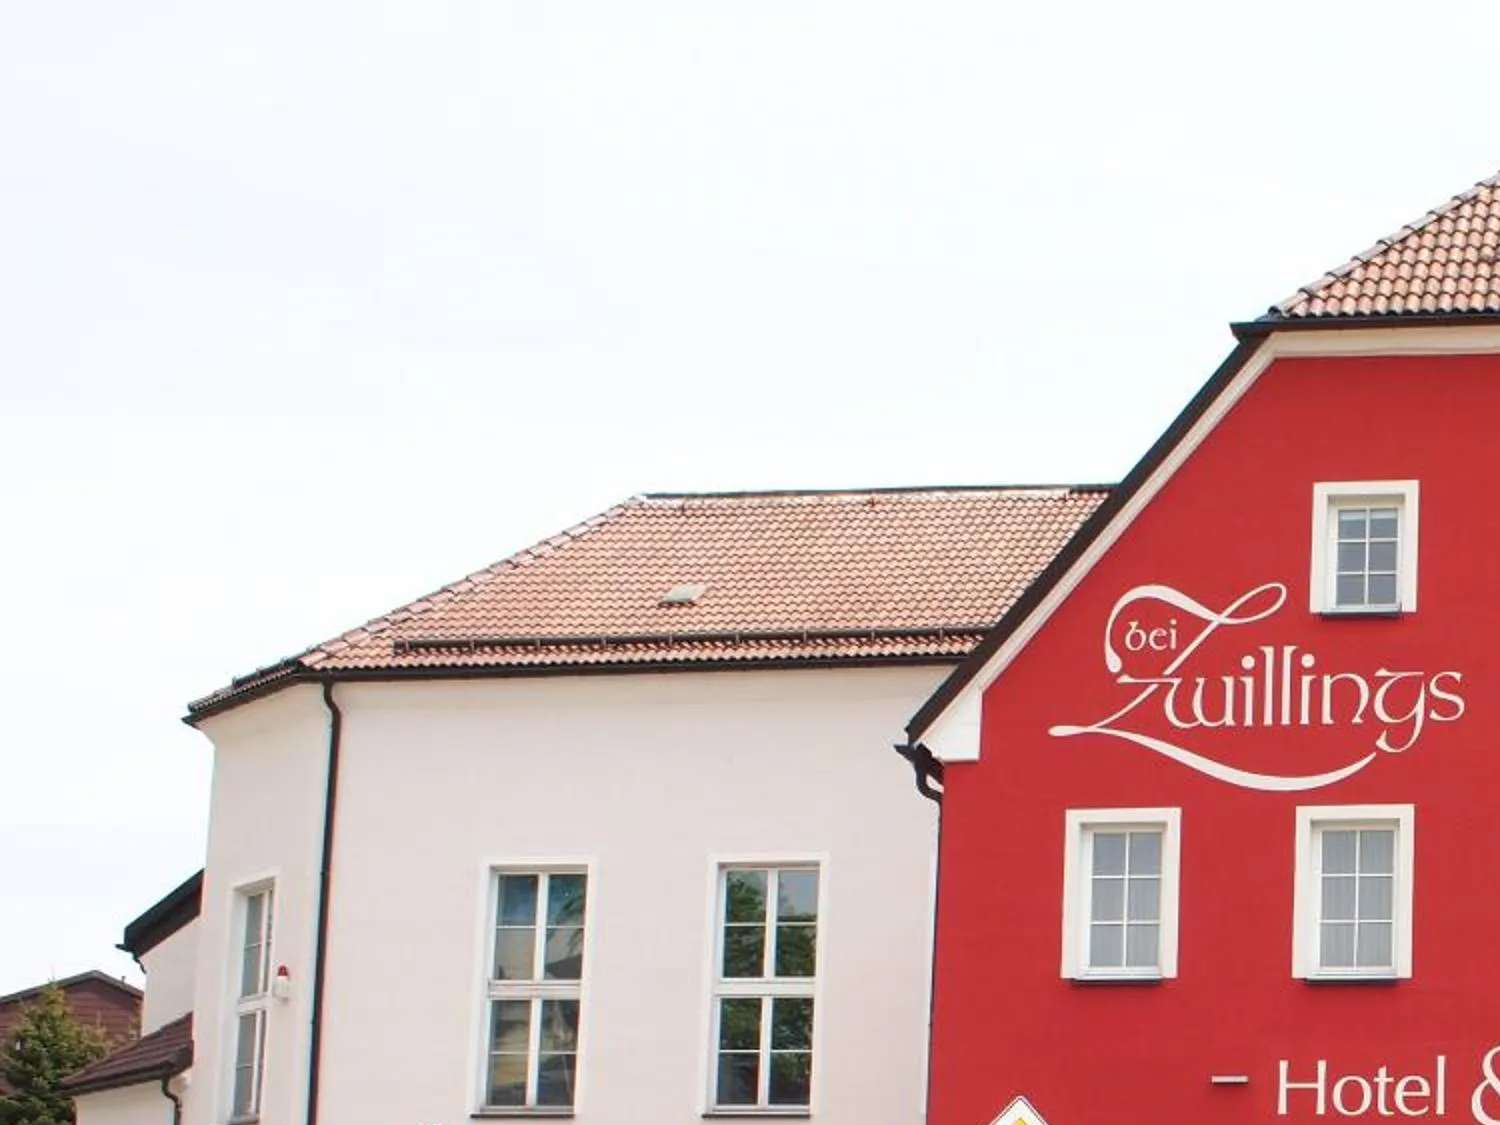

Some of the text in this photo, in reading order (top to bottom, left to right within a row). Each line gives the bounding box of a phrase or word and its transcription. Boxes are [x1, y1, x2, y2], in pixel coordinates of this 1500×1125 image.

[1125, 618, 1177, 651] bei
[1048, 582, 1466, 791] Zwillings
[1276, 1055, 1446, 1116] Hotel
